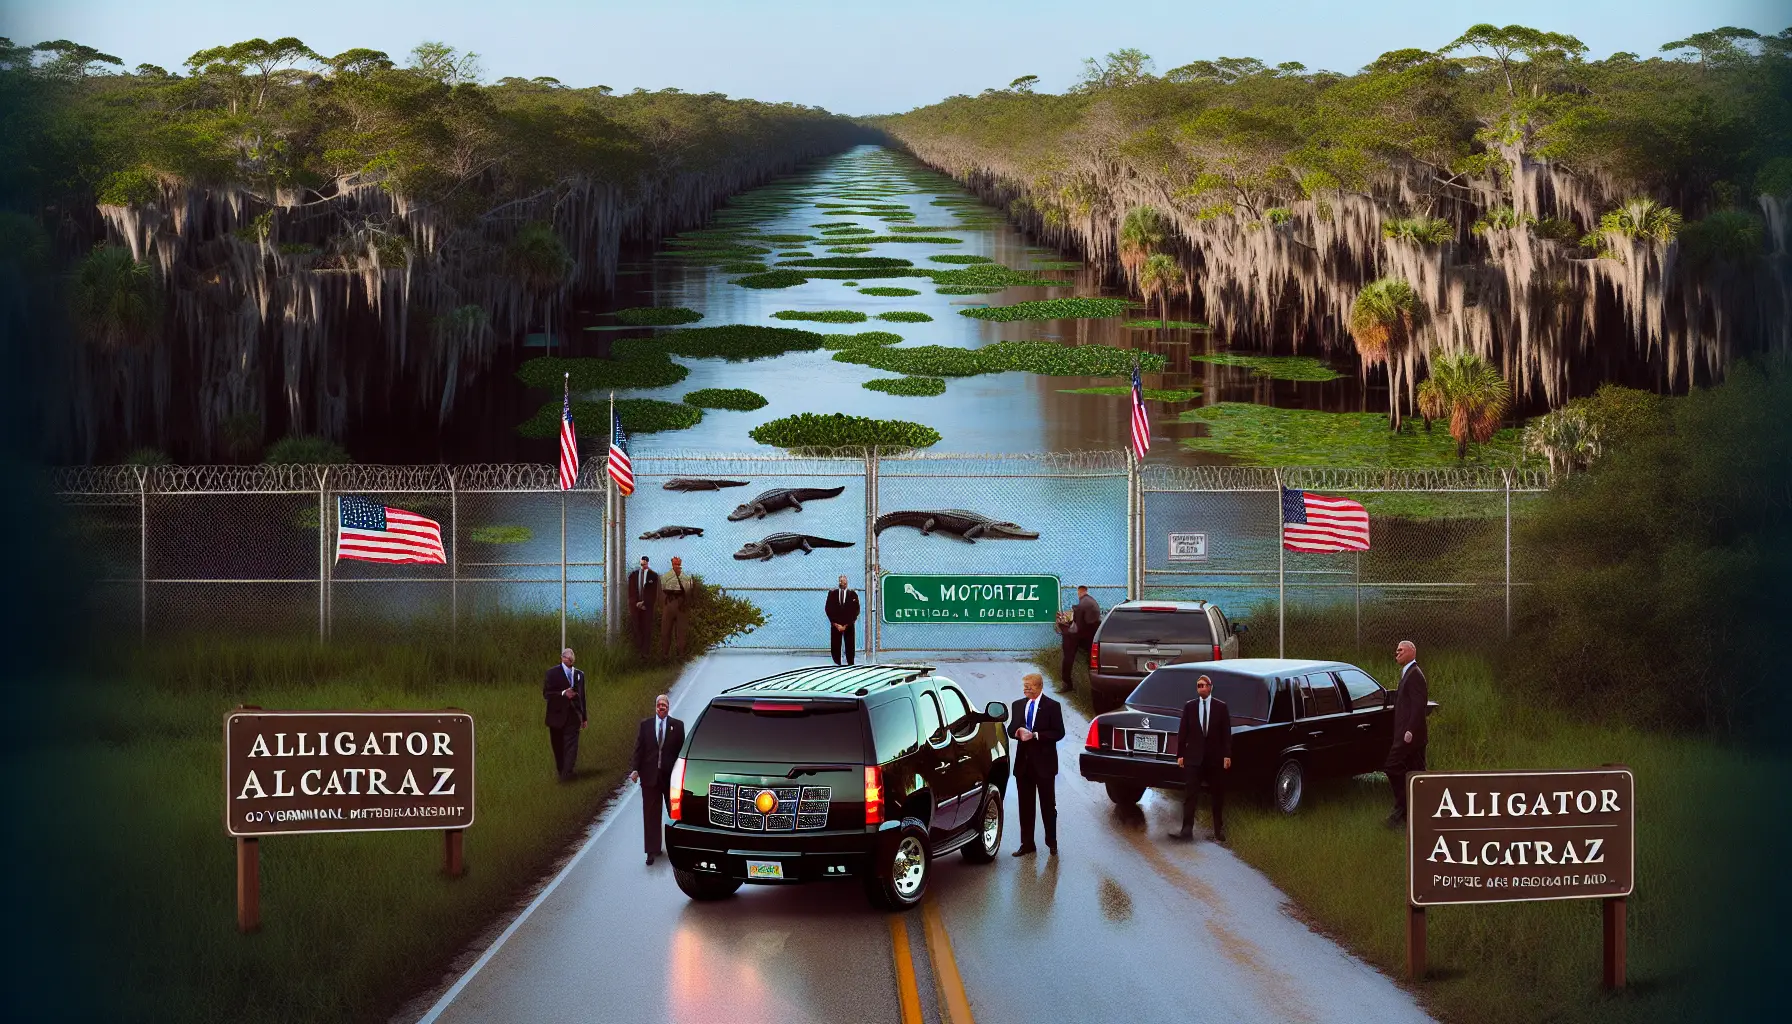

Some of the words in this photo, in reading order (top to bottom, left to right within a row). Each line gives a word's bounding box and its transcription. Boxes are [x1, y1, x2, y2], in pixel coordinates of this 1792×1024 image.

[247, 731, 455, 758] ALLIGATOR
[235, 768, 456, 800] ALCATRAZ
[1431, 787, 1621, 818] ALIGATOR
[1426, 834, 1605, 866] ALCATRAZ
